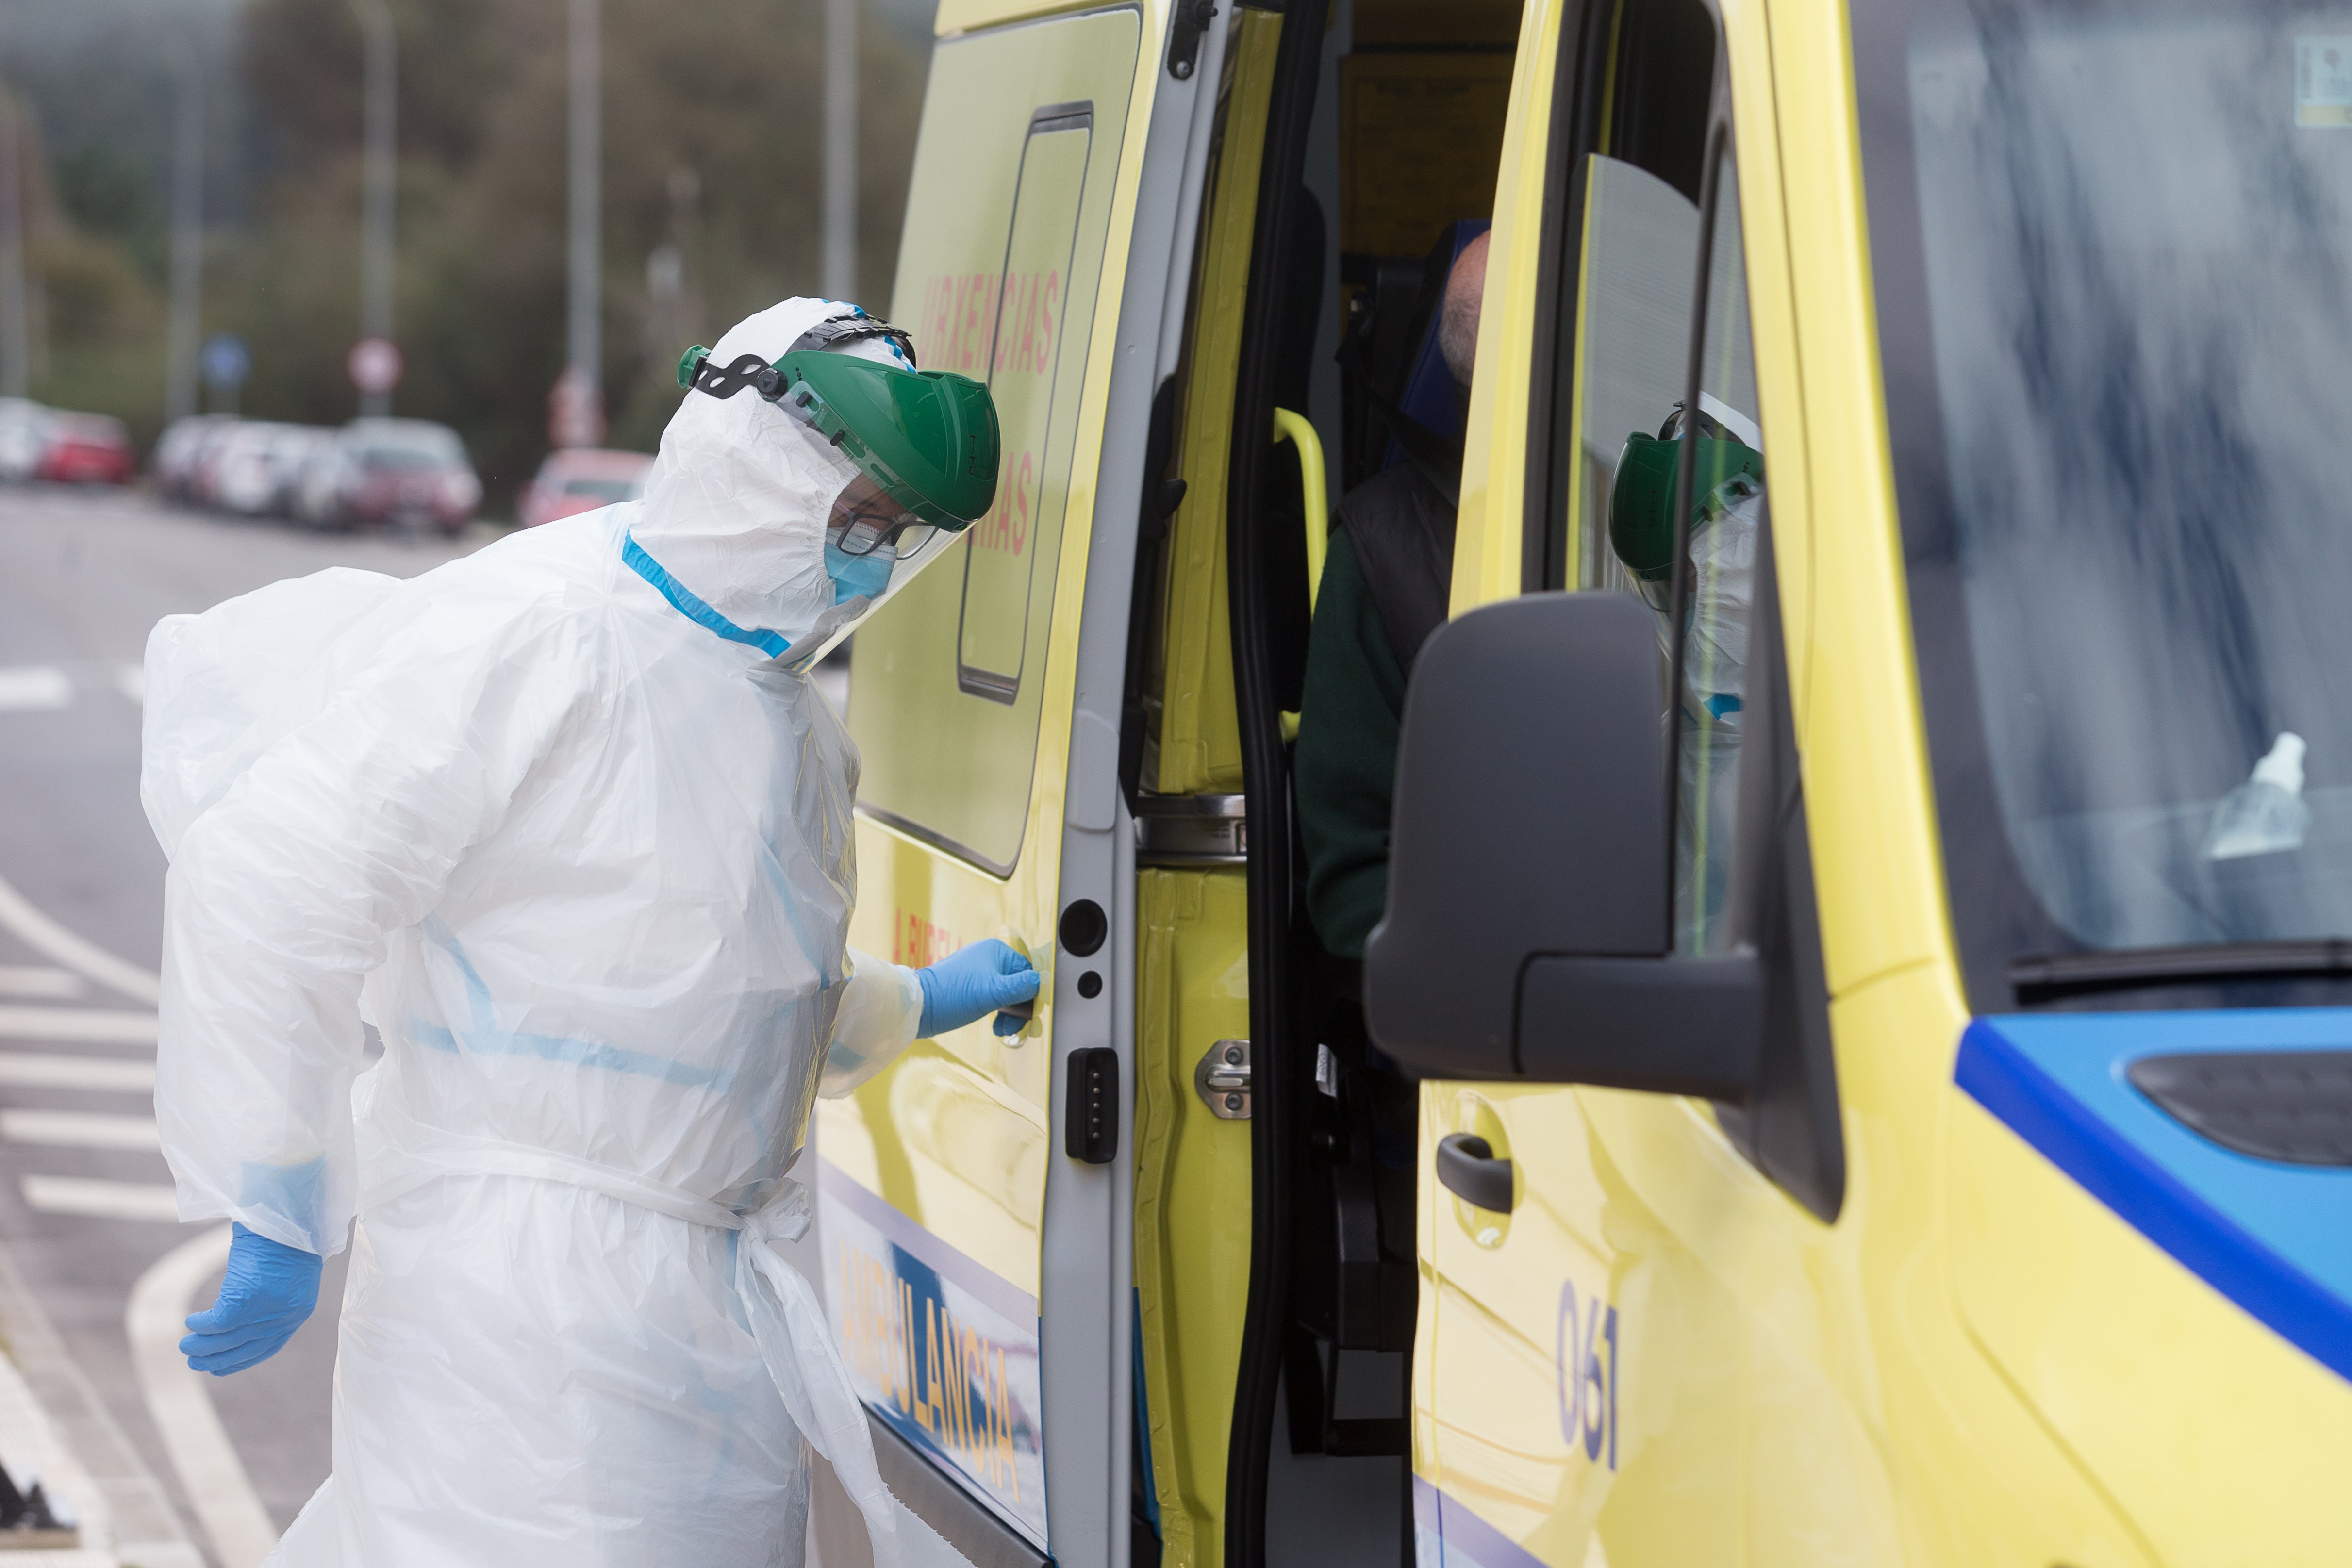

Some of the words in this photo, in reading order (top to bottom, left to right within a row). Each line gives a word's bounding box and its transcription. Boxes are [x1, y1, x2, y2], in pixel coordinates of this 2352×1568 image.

[917, 269, 1058, 375] URXENCIAS
[840, 1238, 1020, 1504] AMBULANCIA
[1558, 1279, 1618, 1471] 061
